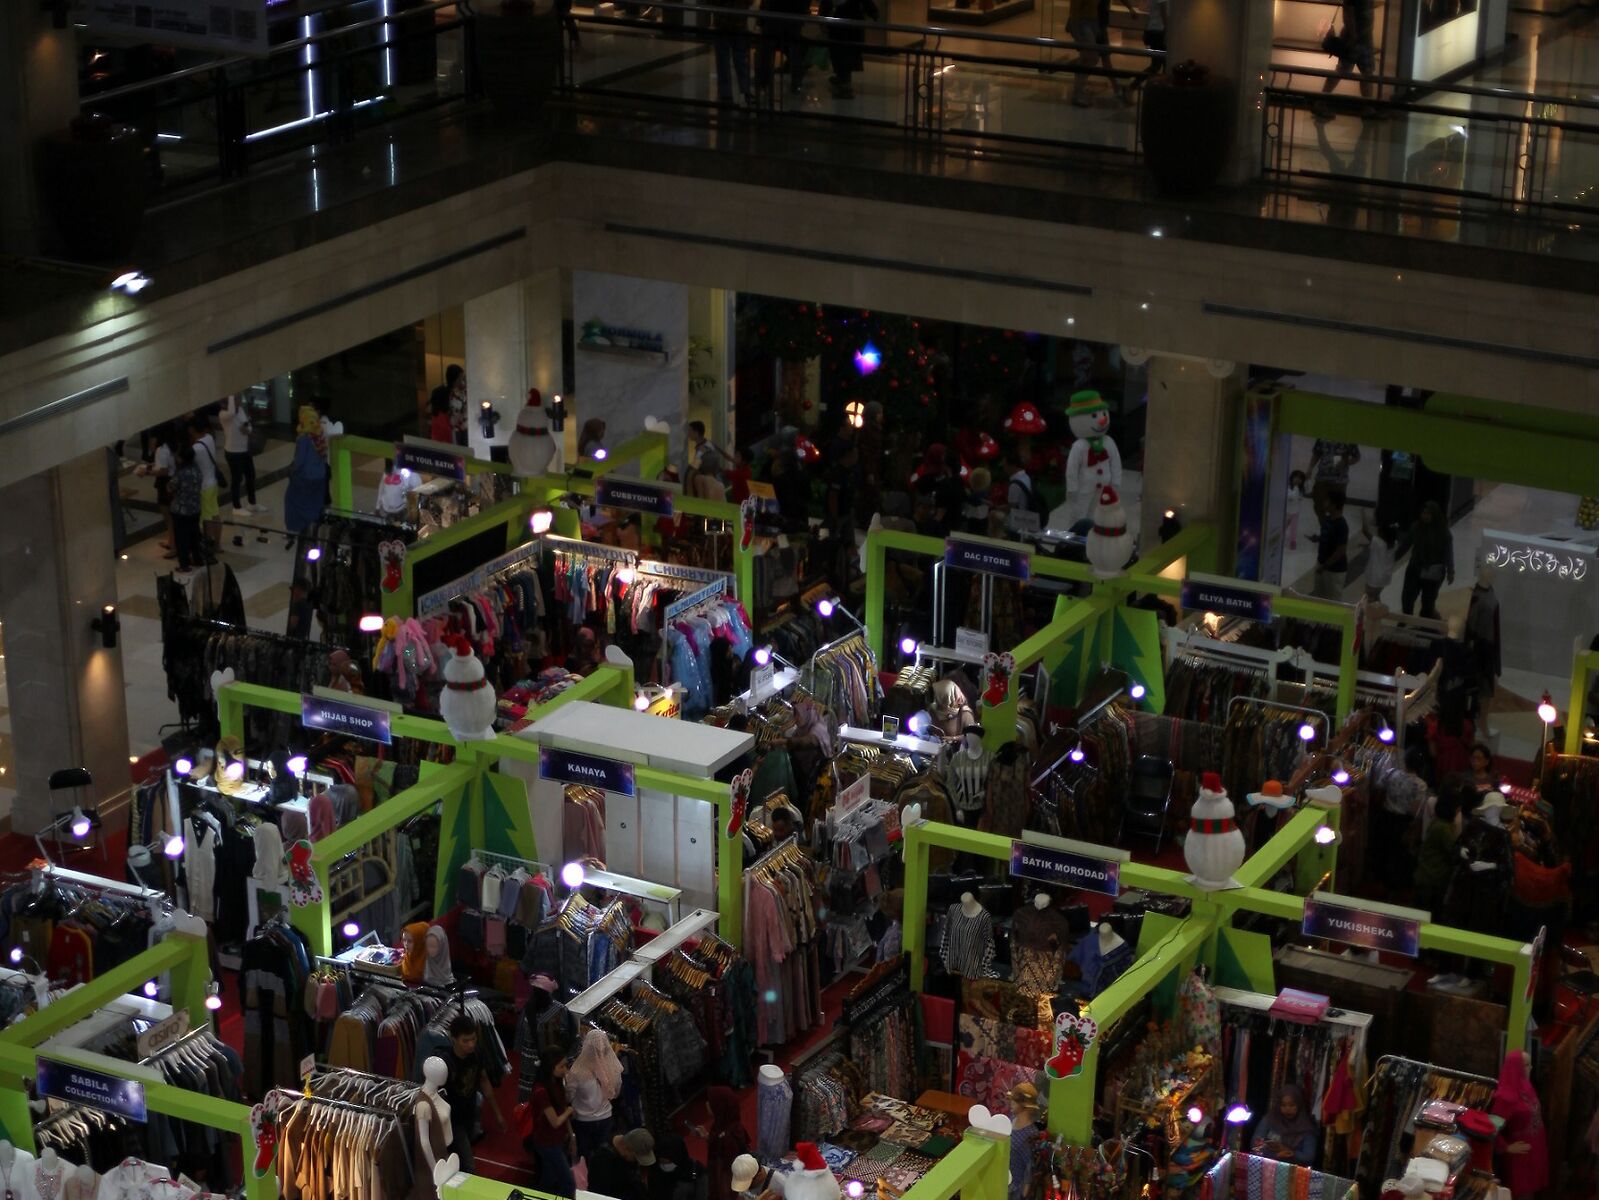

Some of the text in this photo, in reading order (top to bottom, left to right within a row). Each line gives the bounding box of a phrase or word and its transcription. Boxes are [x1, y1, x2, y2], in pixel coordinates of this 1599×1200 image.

[964, 551, 1011, 567] DAC STORE
[1199, 593, 1253, 609] ELIYA BATIK
[321, 711, 373, 728] HIJAB SHOP
[567, 763, 606, 779] KANAYA
[1022, 856, 1108, 881] BATIK MORODADI
[1328, 918, 1394, 939] YUKISHEKA
[70, 1074, 109, 1092] SABILA
[64, 1086, 118, 1105] COLLECTION
